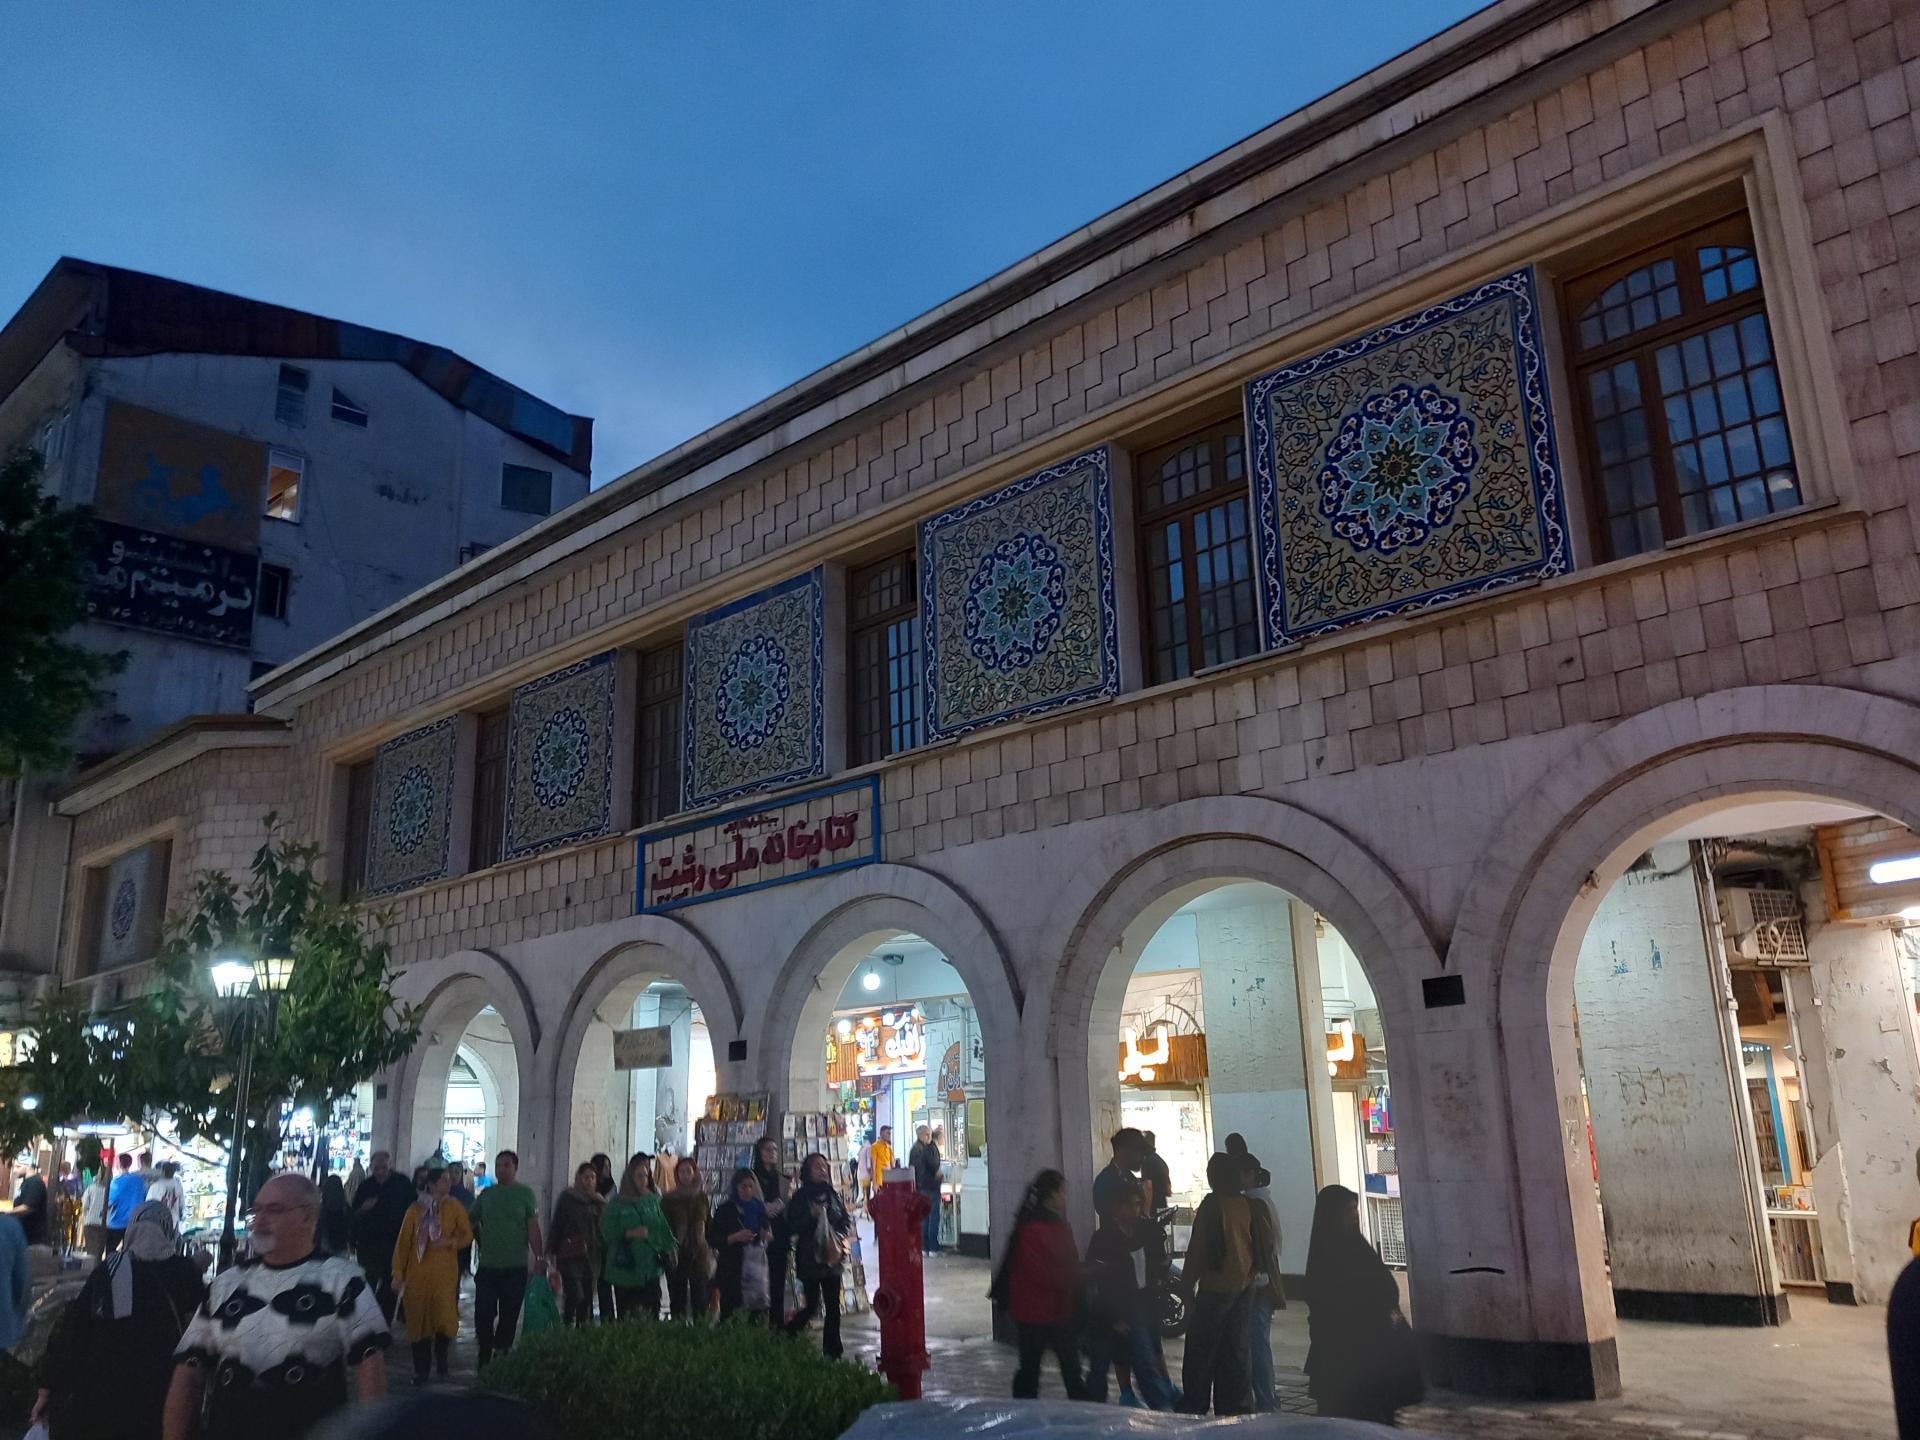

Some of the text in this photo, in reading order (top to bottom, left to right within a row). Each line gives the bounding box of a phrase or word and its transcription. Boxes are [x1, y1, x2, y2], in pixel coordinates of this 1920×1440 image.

[129, 570, 253, 616] ترمیم
[650, 813, 859, 891] کتابخانه ملی رشت
